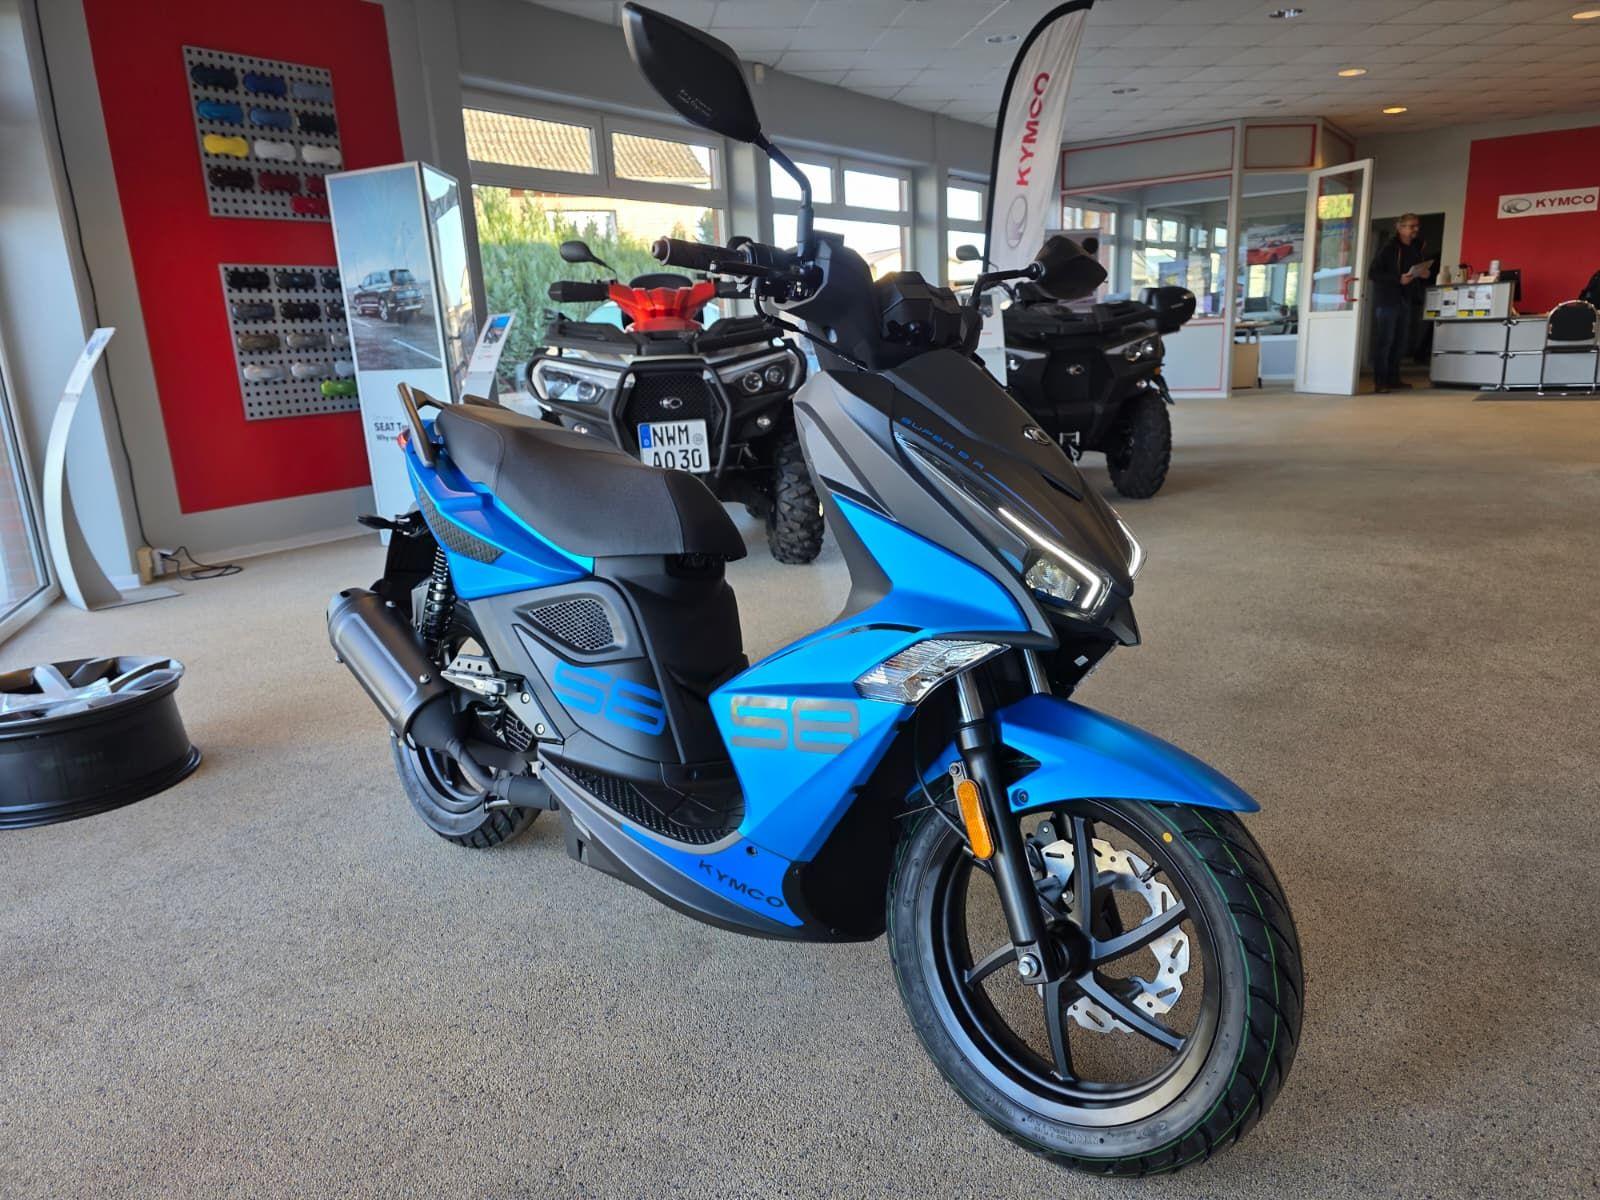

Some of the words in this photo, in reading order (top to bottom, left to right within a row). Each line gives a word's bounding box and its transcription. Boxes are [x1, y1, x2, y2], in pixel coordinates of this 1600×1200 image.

[1016, 72, 1050, 187] KYMCO
[1535, 194, 1596, 209] KYMCO
[374, 421, 395, 431] SEAT
[652, 424, 690, 447] NWM
[699, 859, 784, 908] KYMCO
